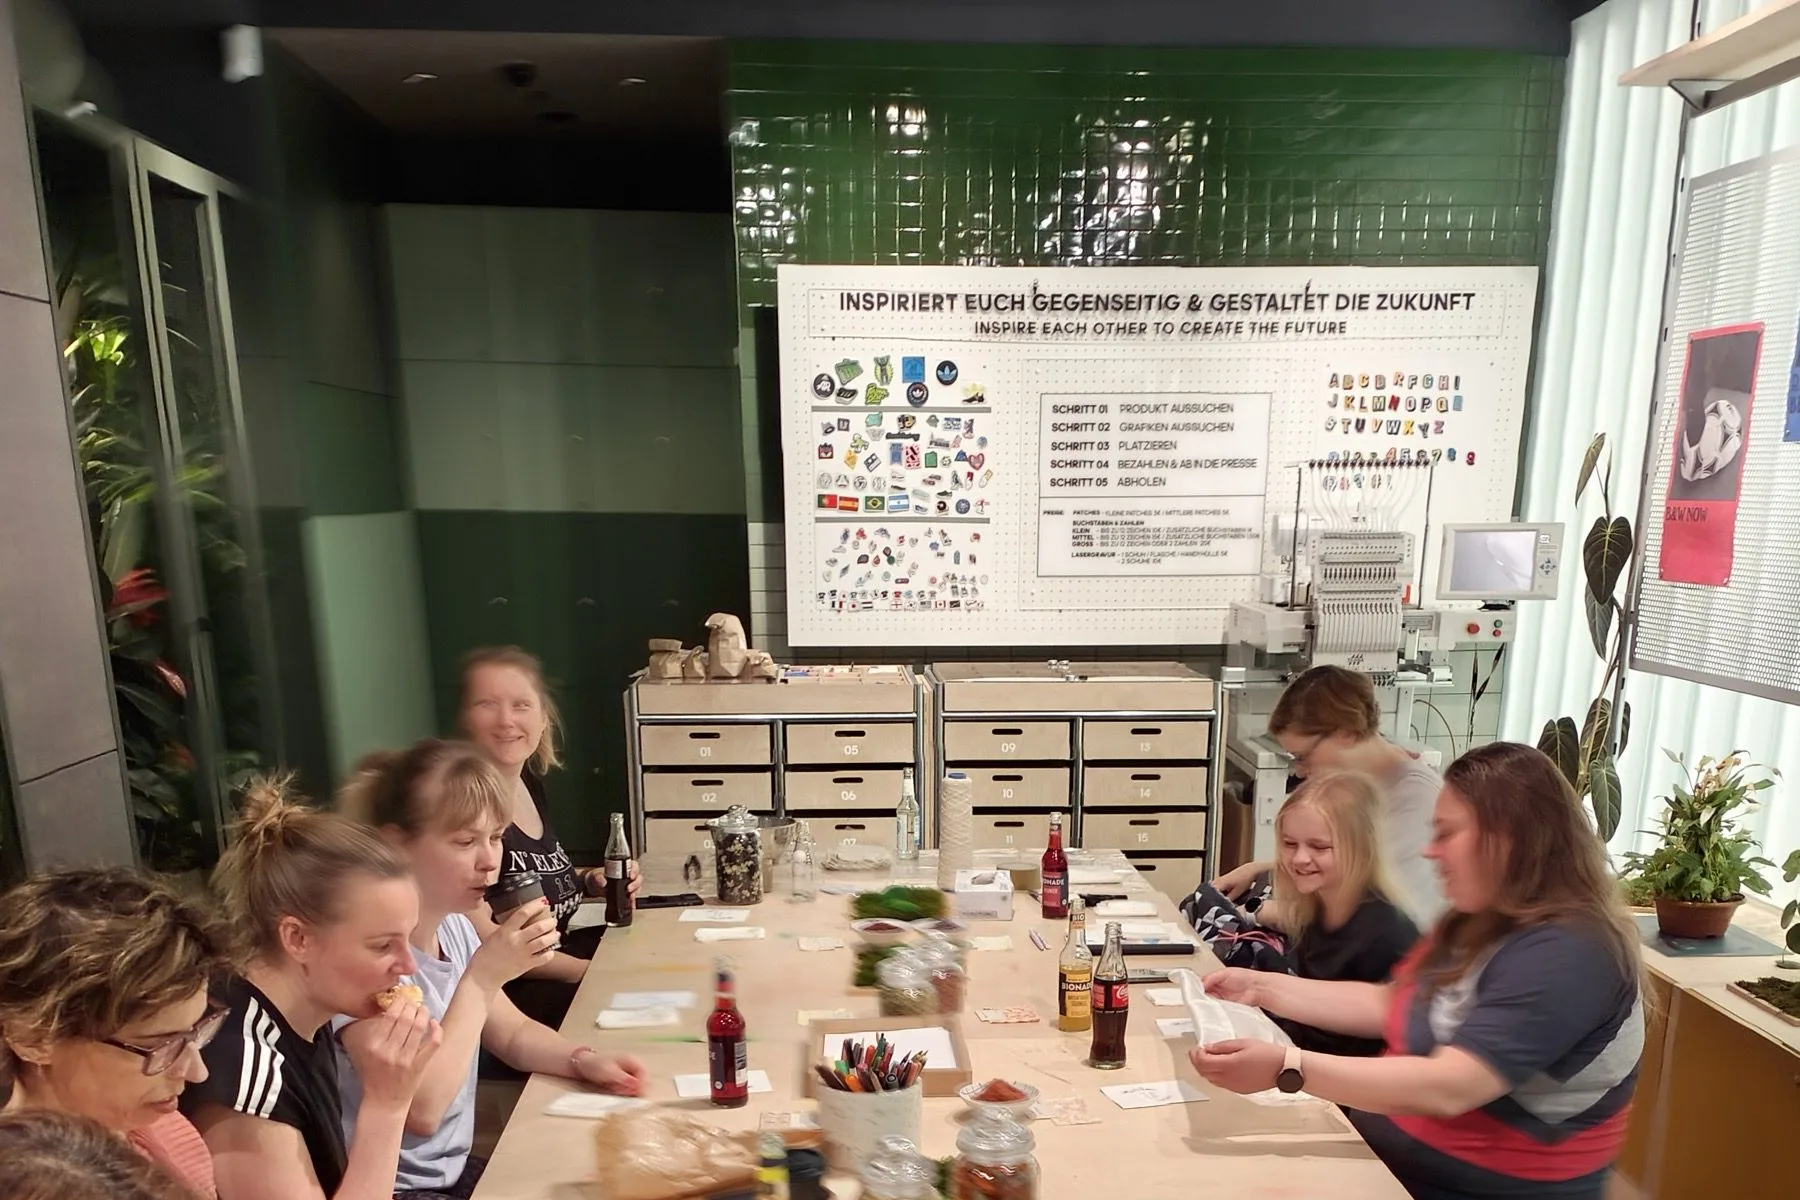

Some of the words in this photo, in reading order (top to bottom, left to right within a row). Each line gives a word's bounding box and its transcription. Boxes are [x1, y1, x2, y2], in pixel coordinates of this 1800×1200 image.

[840, 292, 958, 312] INSPIRIERT
[966, 293, 1025, 312] EUCH
[1032, 293, 1180, 312] GEGENSEITIG
[1187, 294, 1201, 312] &
[1210, 293, 1329, 312] GESTALTET
[1335, 293, 1370, 311] DIE
[1376, 293, 1476, 311] ZUKUNFT
[975, 321, 1036, 335] INSPIRE
[1043, 322, 1087, 335] EACH
[1093, 322, 1147, 335] OTHER
[1154, 322, 1174, 334] TO
[1180, 322, 1244, 335] CREATE
[1250, 322, 1279, 334] THE
[1285, 322, 1347, 334] FUTURE
[1052, 405, 1096, 414] SCHRITT
[1099, 404, 1108, 414] 01
[1120, 404, 1168, 414] PRODUKT
[1171, 403, 1234, 413] AUSSUCHEN
[1052, 423, 1095, 432] SCHRITT
[1098, 423, 1110, 432] 02
[1120, 423, 1168, 432] GRAFIKEN
[1171, 422, 1234, 432] AUSSUCHEN
[1051, 442, 1095, 451] SCHRITT
[1097, 441, 1110, 451] 03
[1118, 441, 1177, 450] PLATZIEREN
[1050, 460, 1094, 468] SCHRITT
[1096, 460, 1109, 468] 04
[1118, 460, 1169, 468] BEZAHLEN
[1221, 459, 1258, 468] PRESSE
[1050, 478, 1093, 487] SCHRITT
[1096, 478, 1108, 487] 05
[1117, 478, 1166, 487] ABHOLEN
[1686, 507, 1708, 521] NOW
[700, 747, 711, 757] 01
[844, 745, 859, 755] 05
[1001, 743, 1016, 753] 09
[702, 793, 717, 803] 02
[841, 791, 856, 801] 06
[1002, 789, 1013, 799] 10
[1140, 789, 1151, 798] 14
[1006, 835, 1013, 844] 11
[1137, 833, 1148, 843] 15
